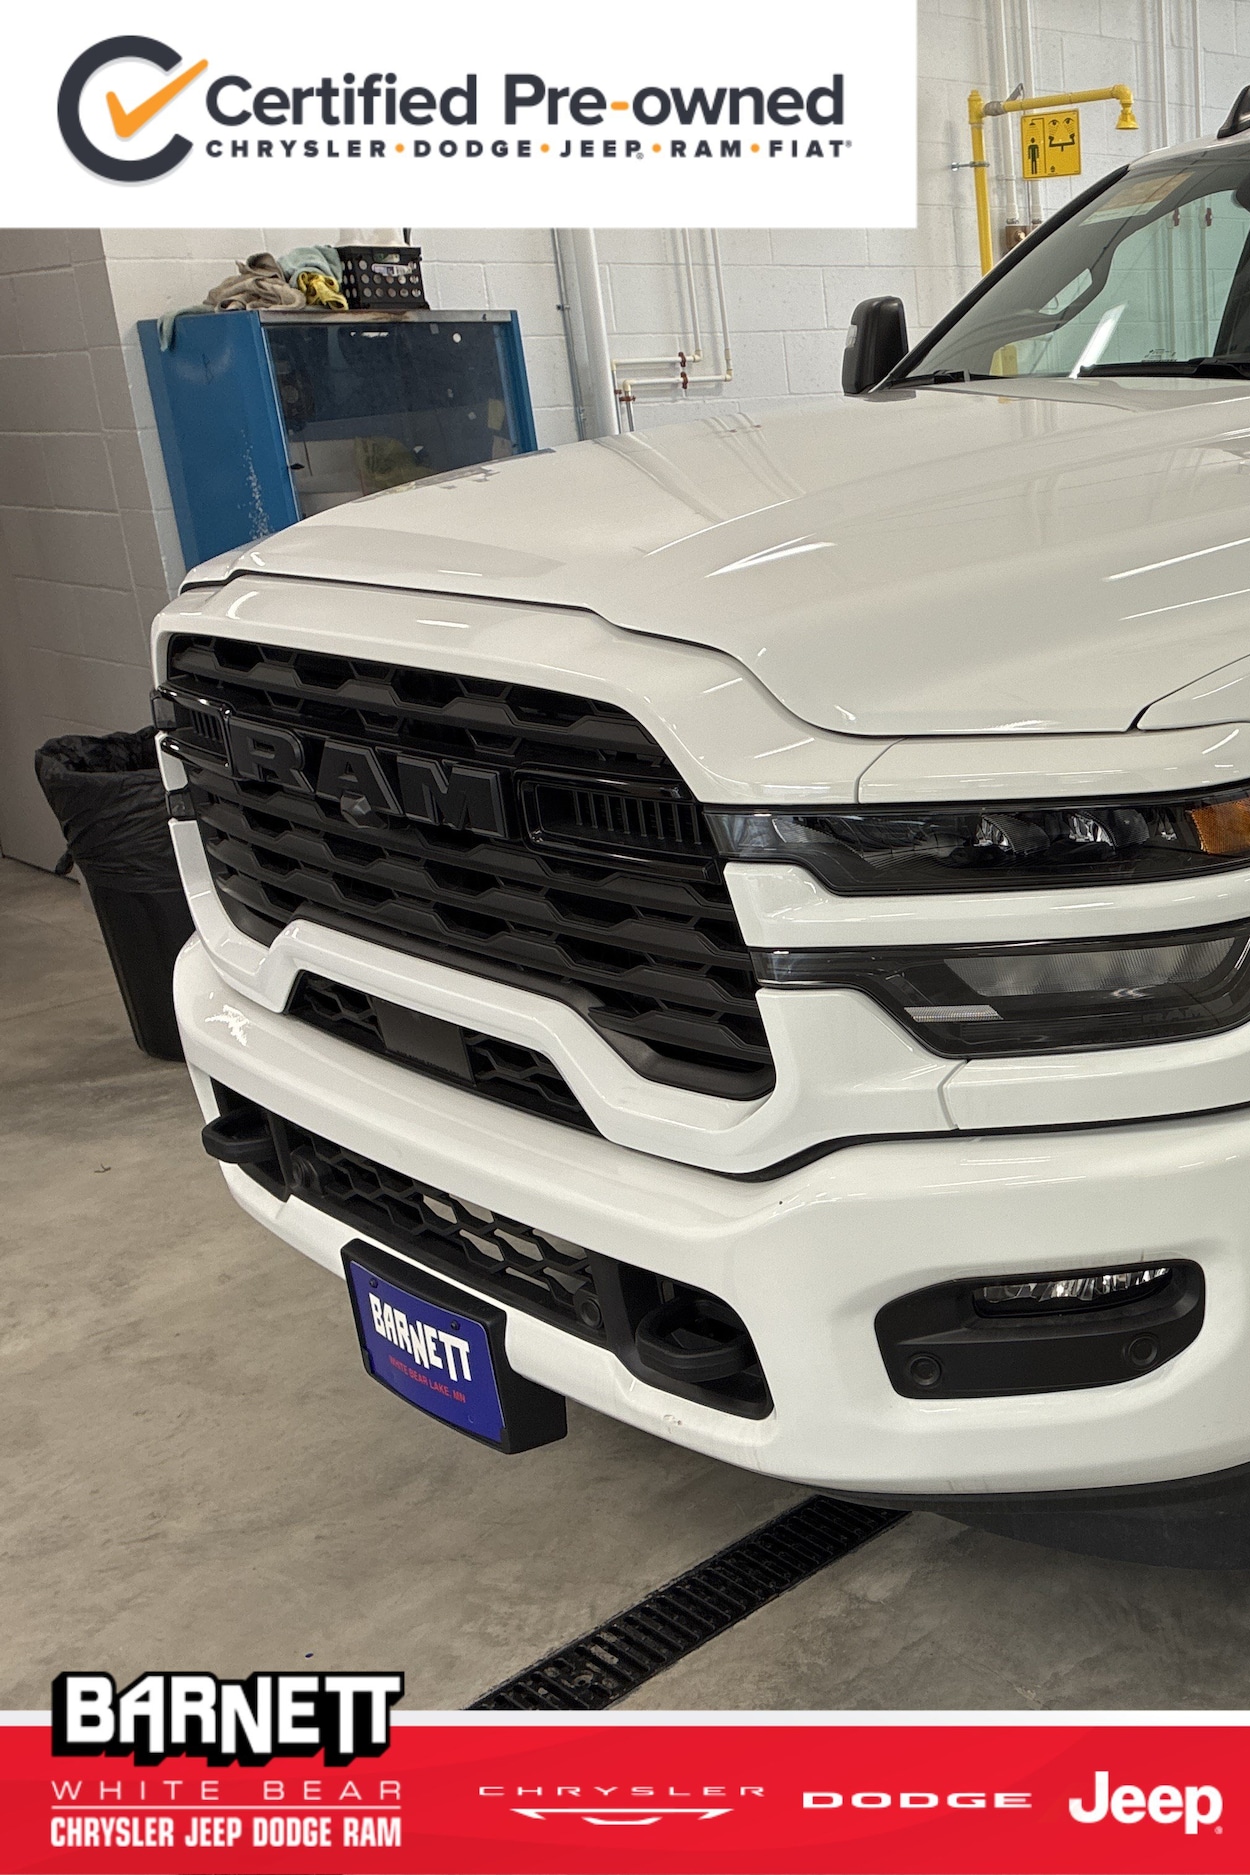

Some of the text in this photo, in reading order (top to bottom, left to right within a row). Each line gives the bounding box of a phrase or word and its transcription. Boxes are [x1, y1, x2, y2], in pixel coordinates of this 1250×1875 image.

[227, 716, 509, 840] RAM
[368, 1291, 472, 1382] BARNETT
[388, 1354, 409, 1376] WHITE
[408, 1368, 429, 1387] BEAR
[452, 1389, 467, 1404] MN
